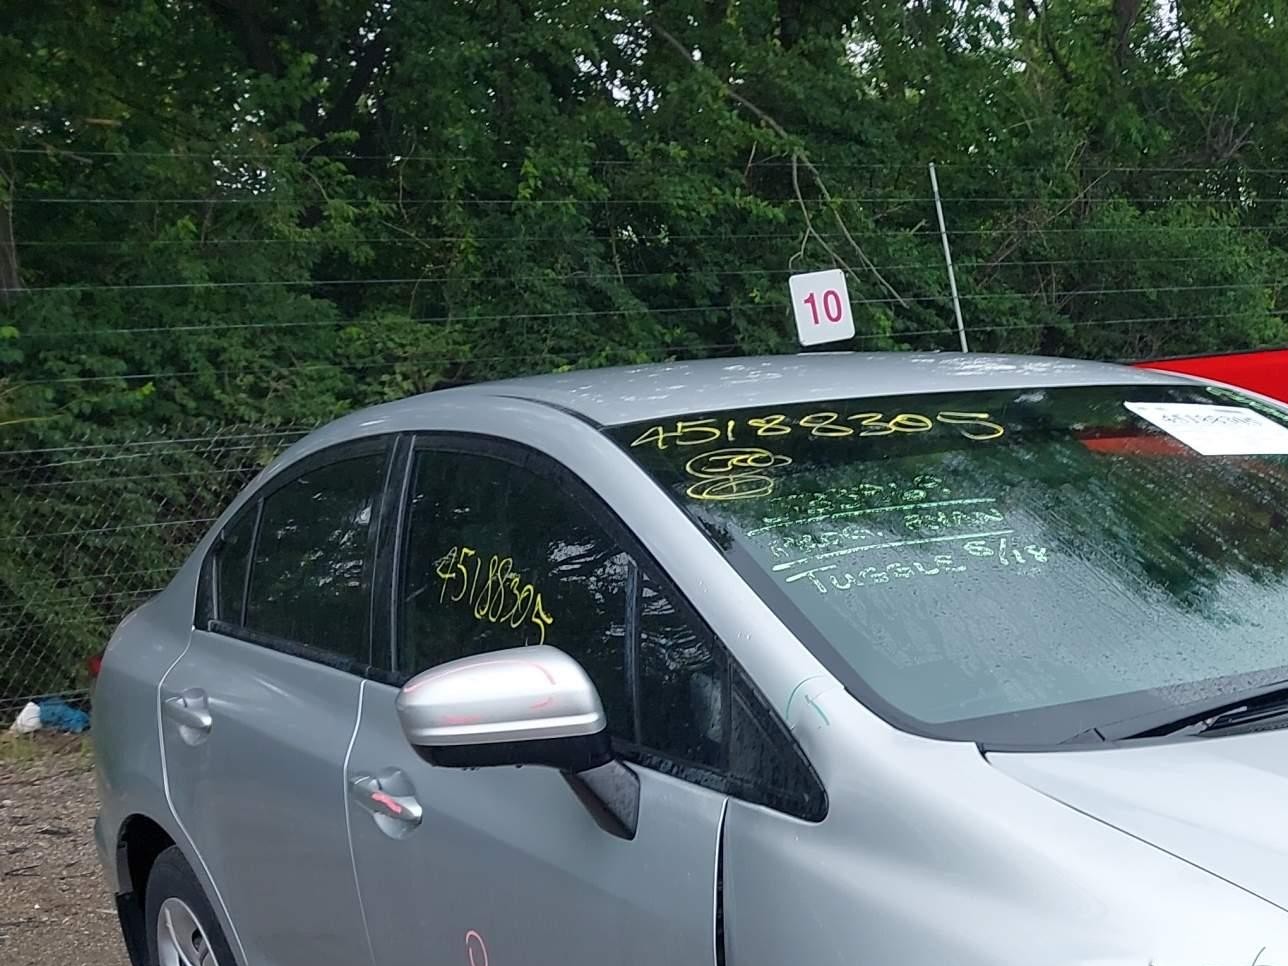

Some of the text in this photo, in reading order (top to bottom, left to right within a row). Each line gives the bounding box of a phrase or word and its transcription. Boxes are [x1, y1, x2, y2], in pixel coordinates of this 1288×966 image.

[803, 289, 843, 325] 10
[630, 411, 1004, 449] 45188305
[434, 546, 554, 645] 45188305
